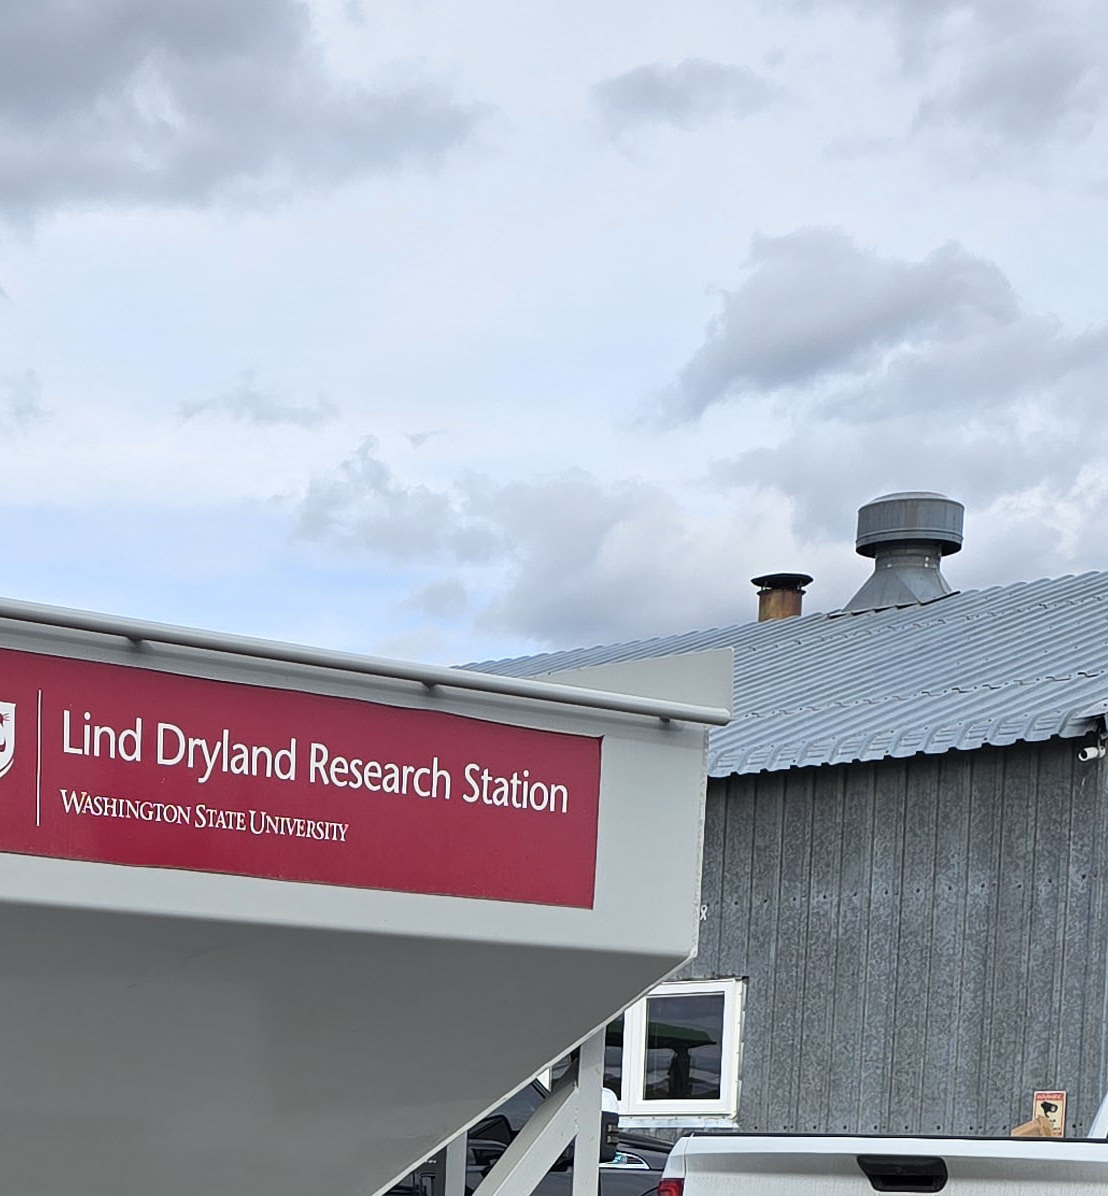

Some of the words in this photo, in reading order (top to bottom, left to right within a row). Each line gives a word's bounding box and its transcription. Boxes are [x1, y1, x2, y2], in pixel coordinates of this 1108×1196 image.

[62, 709, 143, 763] Lind
[156, 722, 298, 784] Dryland
[308, 742, 452, 800] Research
[461, 763, 569, 814] Station
[59, 788, 193, 826] WASHINGTON
[193, 803, 247, 833] STATE
[247, 808, 350, 843] UNIVERSITY
